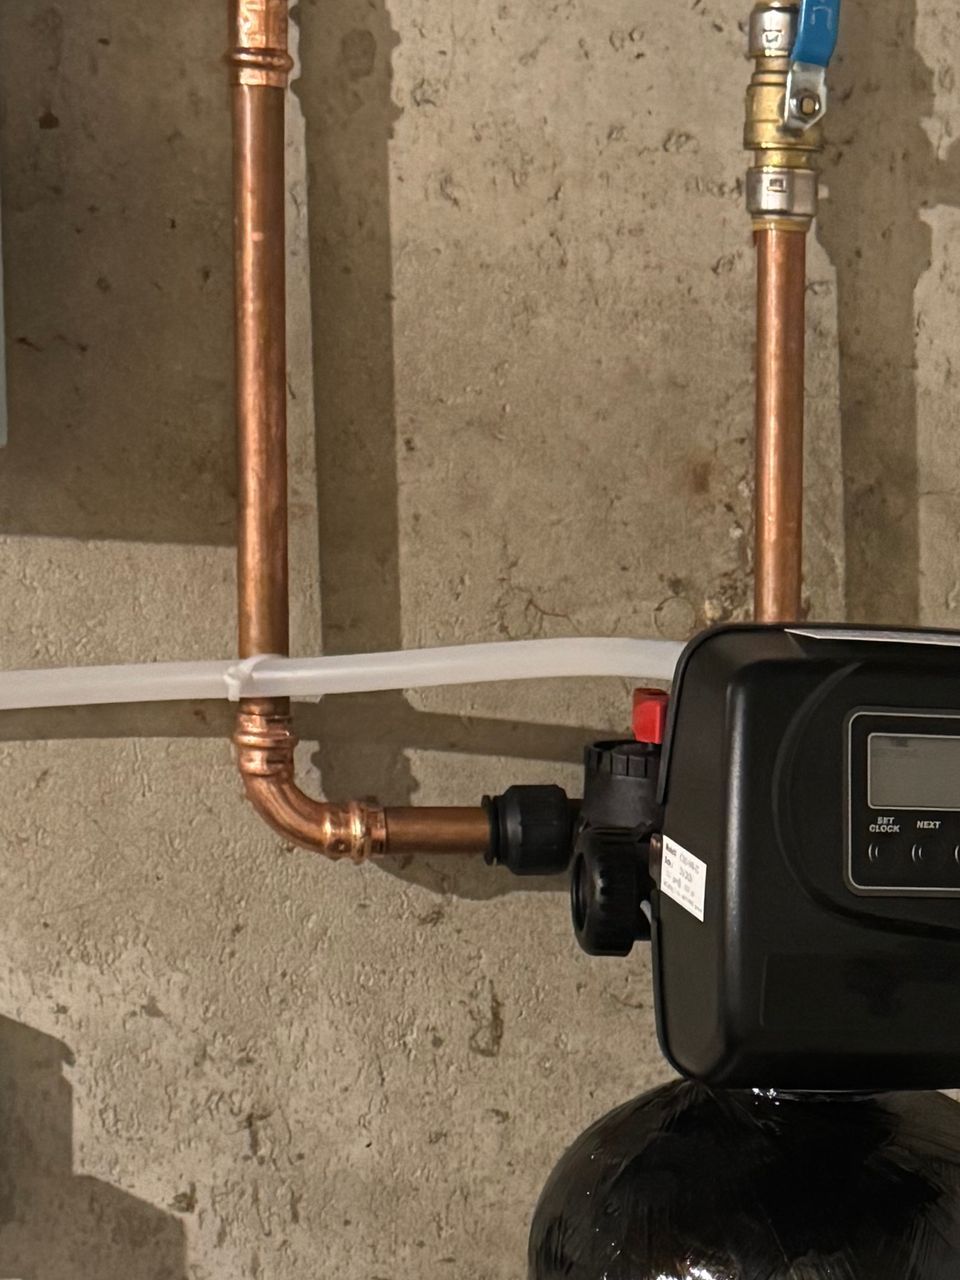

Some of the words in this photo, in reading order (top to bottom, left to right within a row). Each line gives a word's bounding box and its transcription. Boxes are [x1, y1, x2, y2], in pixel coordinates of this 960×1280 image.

[877, 816, 895, 824] SET
[916, 820, 941, 829] NEXT
[869, 824, 900, 833] CLOCK
